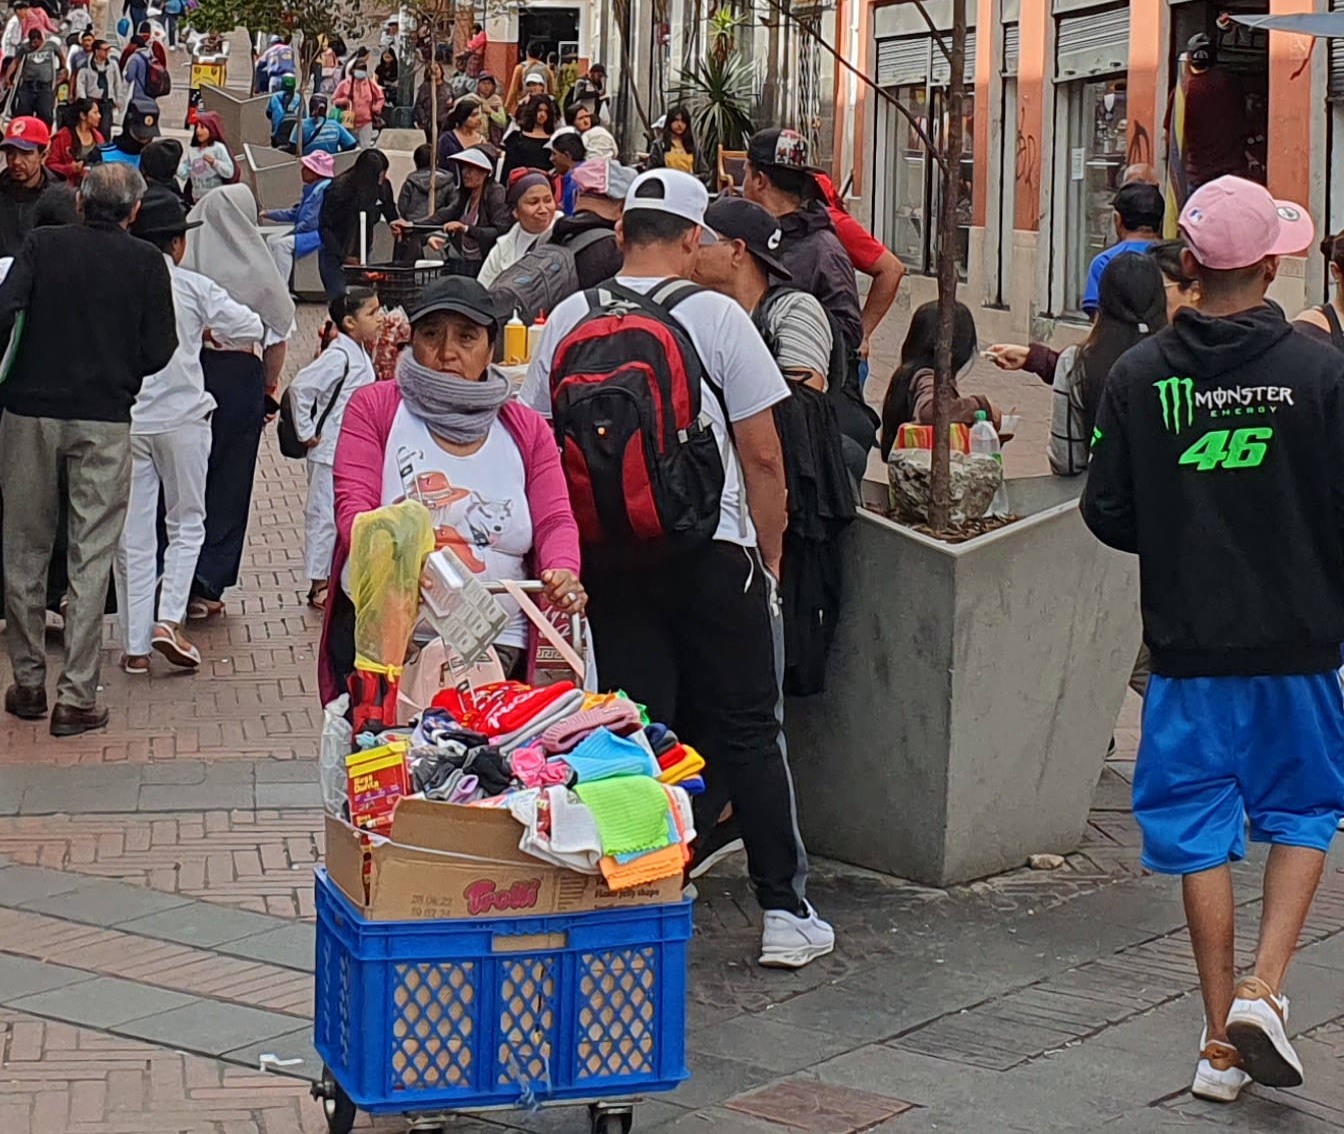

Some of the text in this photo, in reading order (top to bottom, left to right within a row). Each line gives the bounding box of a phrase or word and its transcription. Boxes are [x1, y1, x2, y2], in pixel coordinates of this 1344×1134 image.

[1195, 385, 1295, 409] MONSTER
[1210, 406, 1277, 417] ENERGY
[1178, 427, 1273, 471] 46
[463, 878, 542, 915] Trolli
